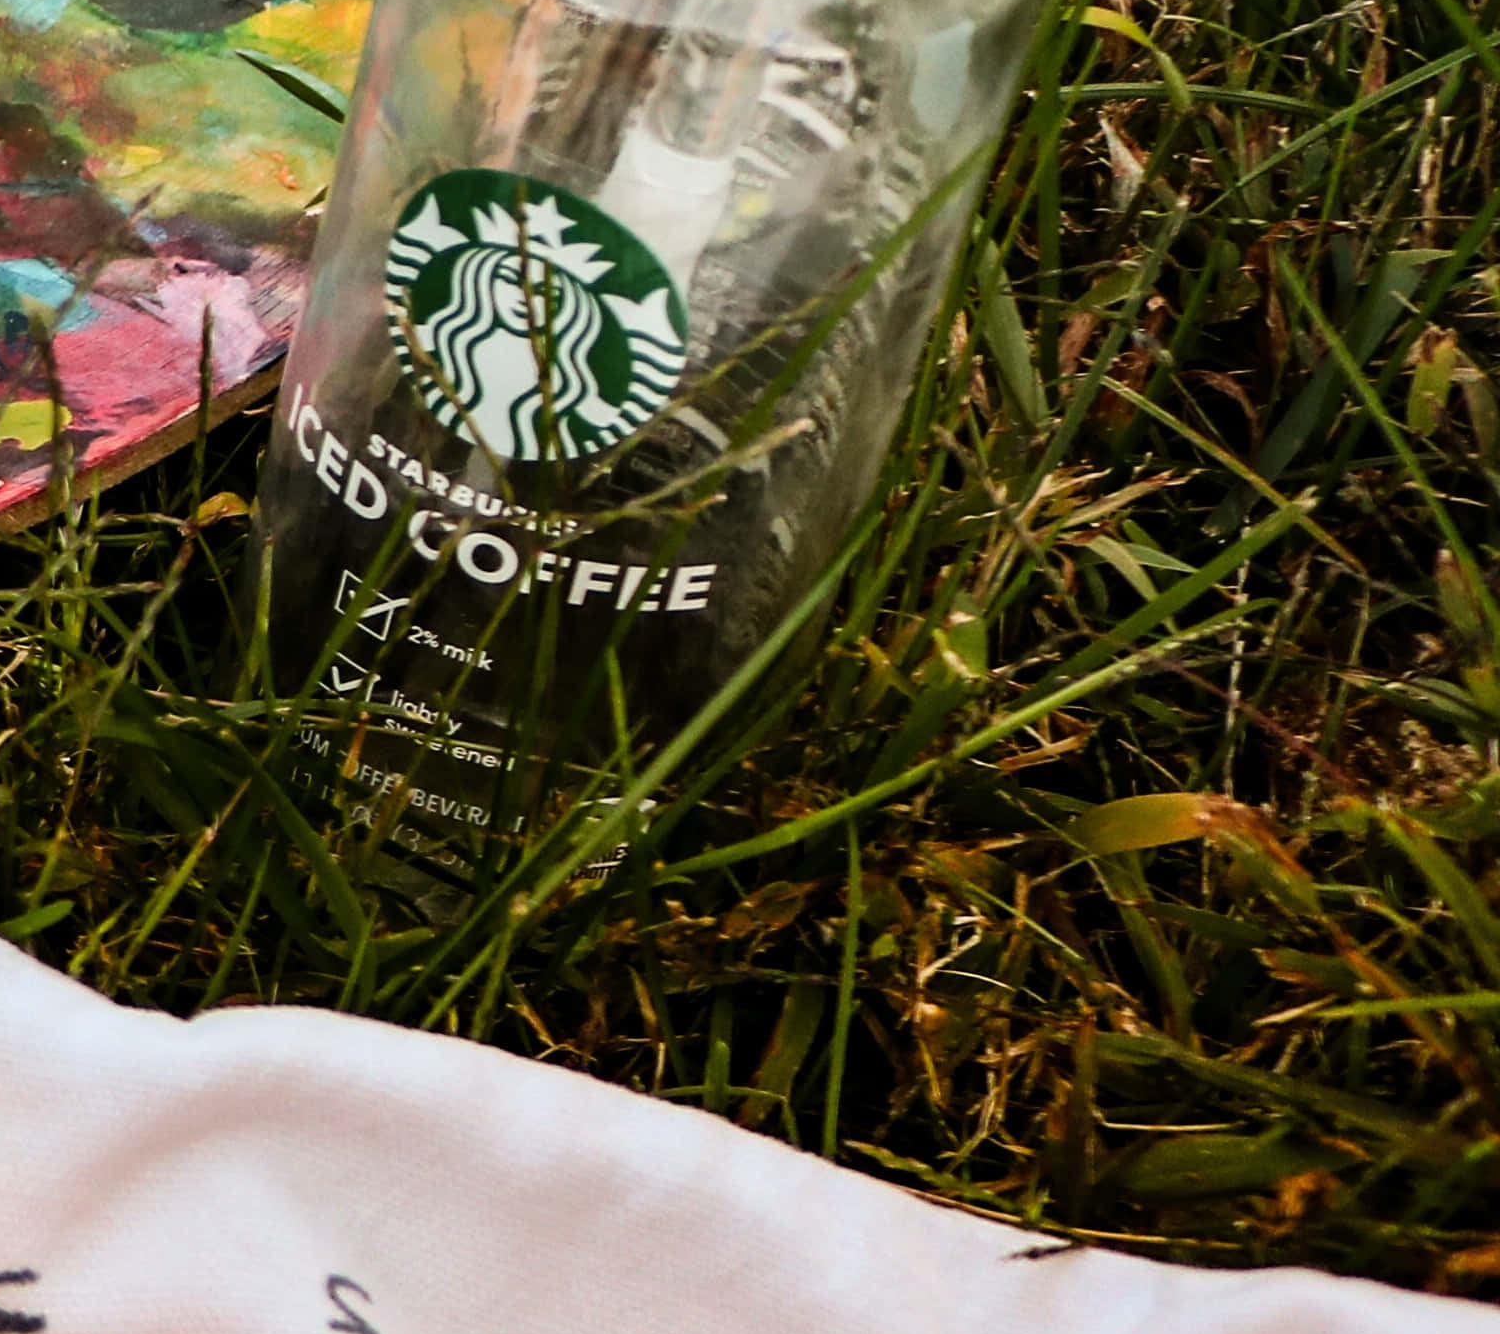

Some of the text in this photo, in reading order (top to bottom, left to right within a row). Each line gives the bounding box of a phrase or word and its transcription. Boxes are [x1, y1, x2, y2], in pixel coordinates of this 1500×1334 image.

[286, 382, 388, 520] ICED
[406, 624, 495, 672] 2% mik
